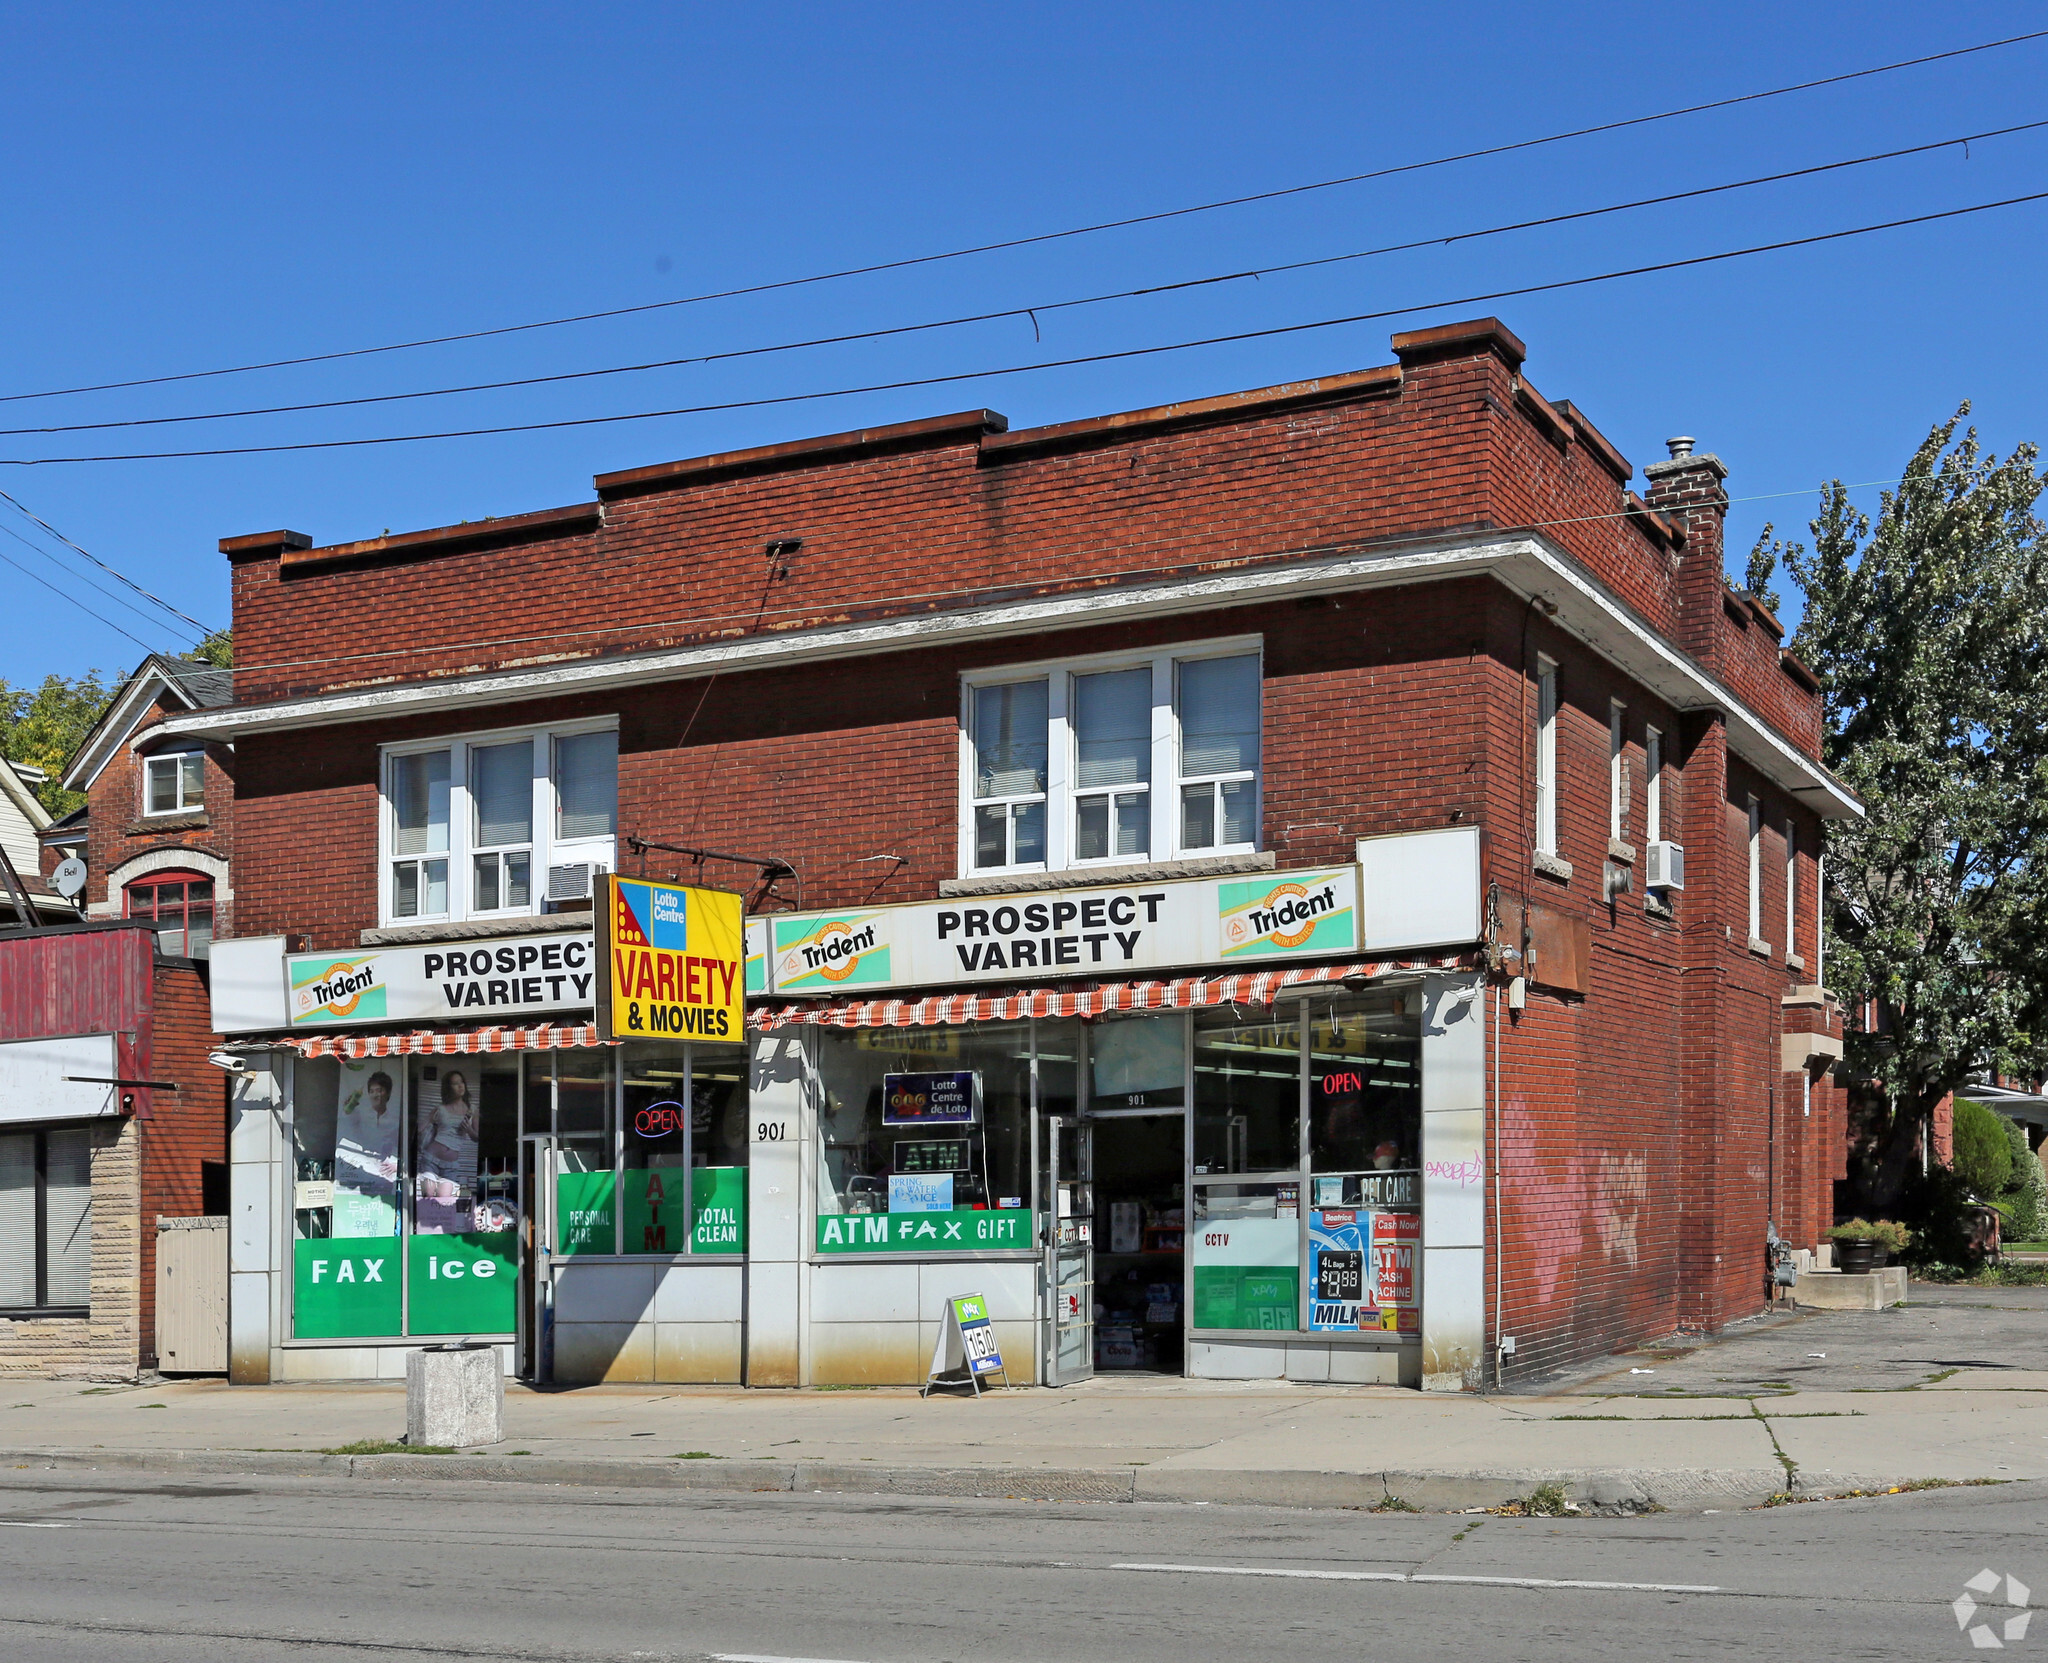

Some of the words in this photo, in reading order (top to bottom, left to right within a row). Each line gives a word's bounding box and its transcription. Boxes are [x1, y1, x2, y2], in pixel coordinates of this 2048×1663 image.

[64, 867, 77, 876] Bell
[654, 890, 678, 908] Lotto
[654, 906, 685, 924] Centre
[937, 893, 1165, 939] PROSPECT
[1249, 887, 1334, 934] Trident
[802, 926, 875, 968] Trident
[956, 930, 1141, 971] VARIETY
[424, 941, 593, 979] PROSPEC
[313, 966, 373, 1004] Trident
[615, 948, 737, 1006] VARIETY
[443, 973, 593, 1008] VARIETY
[628, 1002, 644, 1030] &
[650, 1004, 729, 1036] MOVIES
[931, 1081, 957, 1090] Lotto
[1323, 1072, 1361, 1094] OPEN
[931, 1093, 963, 1102] Centre
[1128, 1094, 1145, 1106] 901
[931, 1104, 943, 1114] de
[946, 1104, 967, 1113] Loto
[635, 1109, 684, 1131] OPEN
[758, 1122, 785, 1141] 901
[904, 1144, 958, 1170] ATM
[890, 1177, 922, 1187] SPRING
[907, 1185, 937, 1193] WATER
[1362, 1177, 1381, 1203] PET
[1386, 1176, 1411, 1202] CARE
[920, 1194, 937, 1202] ICE
[569, 1210, 610, 1226] PERSONAL
[697, 1208, 736, 1224] TOTAL
[1325, 1214, 1353, 1222] Beatrice
[1378, 1220, 1397, 1230] Cash
[1400, 1220, 1418, 1229] Now!
[570, 1228, 591, 1243] CARE
[698, 1226, 737, 1243] CLEAN
[822, 1216, 888, 1244] ATM
[899, 1220, 962, 1240] FAX
[977, 1219, 1016, 1239] GIFT
[1205, 1233, 1229, 1246] CCTV
[1333, 1261, 1345, 1269] Bags
[1373, 1248, 1411, 1268] ATM
[312, 1259, 384, 1284] FAX
[429, 1256, 496, 1280] ice
[1378, 1272, 1402, 1283] CASH
[1378, 1287, 1410, 1297] ACHINE
